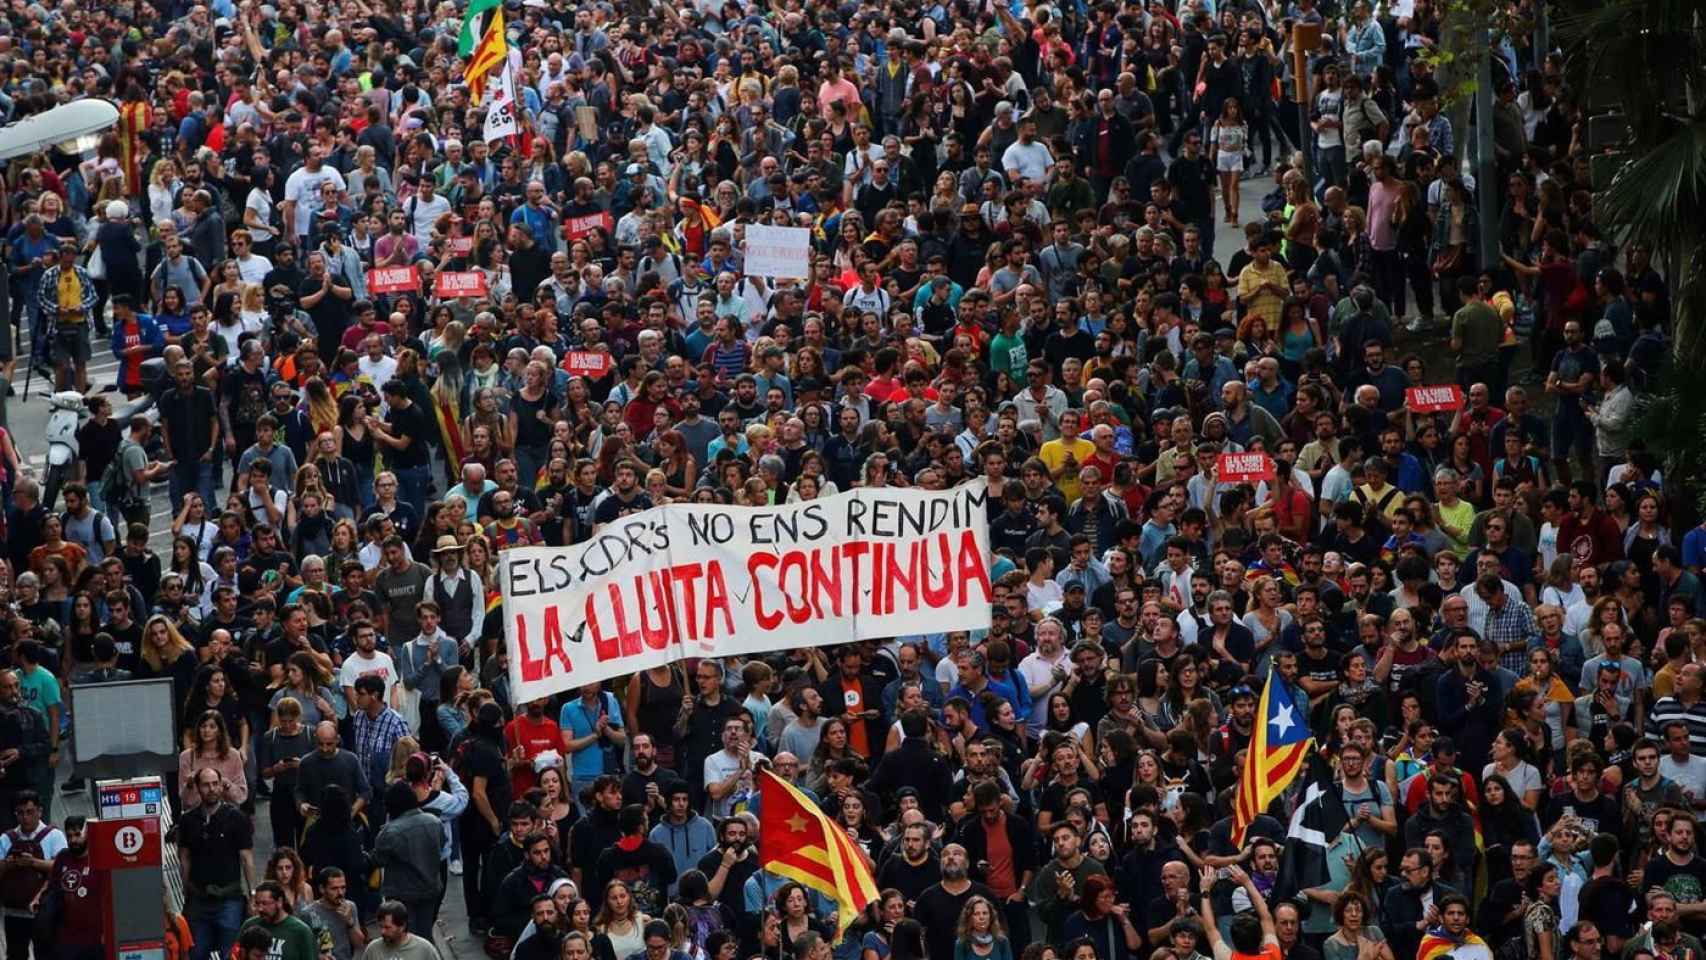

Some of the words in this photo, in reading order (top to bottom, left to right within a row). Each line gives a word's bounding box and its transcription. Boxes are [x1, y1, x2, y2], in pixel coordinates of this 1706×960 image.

[509, 554, 572, 597] ELS
[687, 512, 735, 546] NO
[749, 504, 828, 544] ENS
[515, 605, 574, 682] LA
[585, 558, 736, 663] LLUITA
[747, 530, 994, 631] CONTINUA
[102, 795, 121, 804] H16
[125, 792, 136, 803] 19
[123, 832, 136, 848] B
